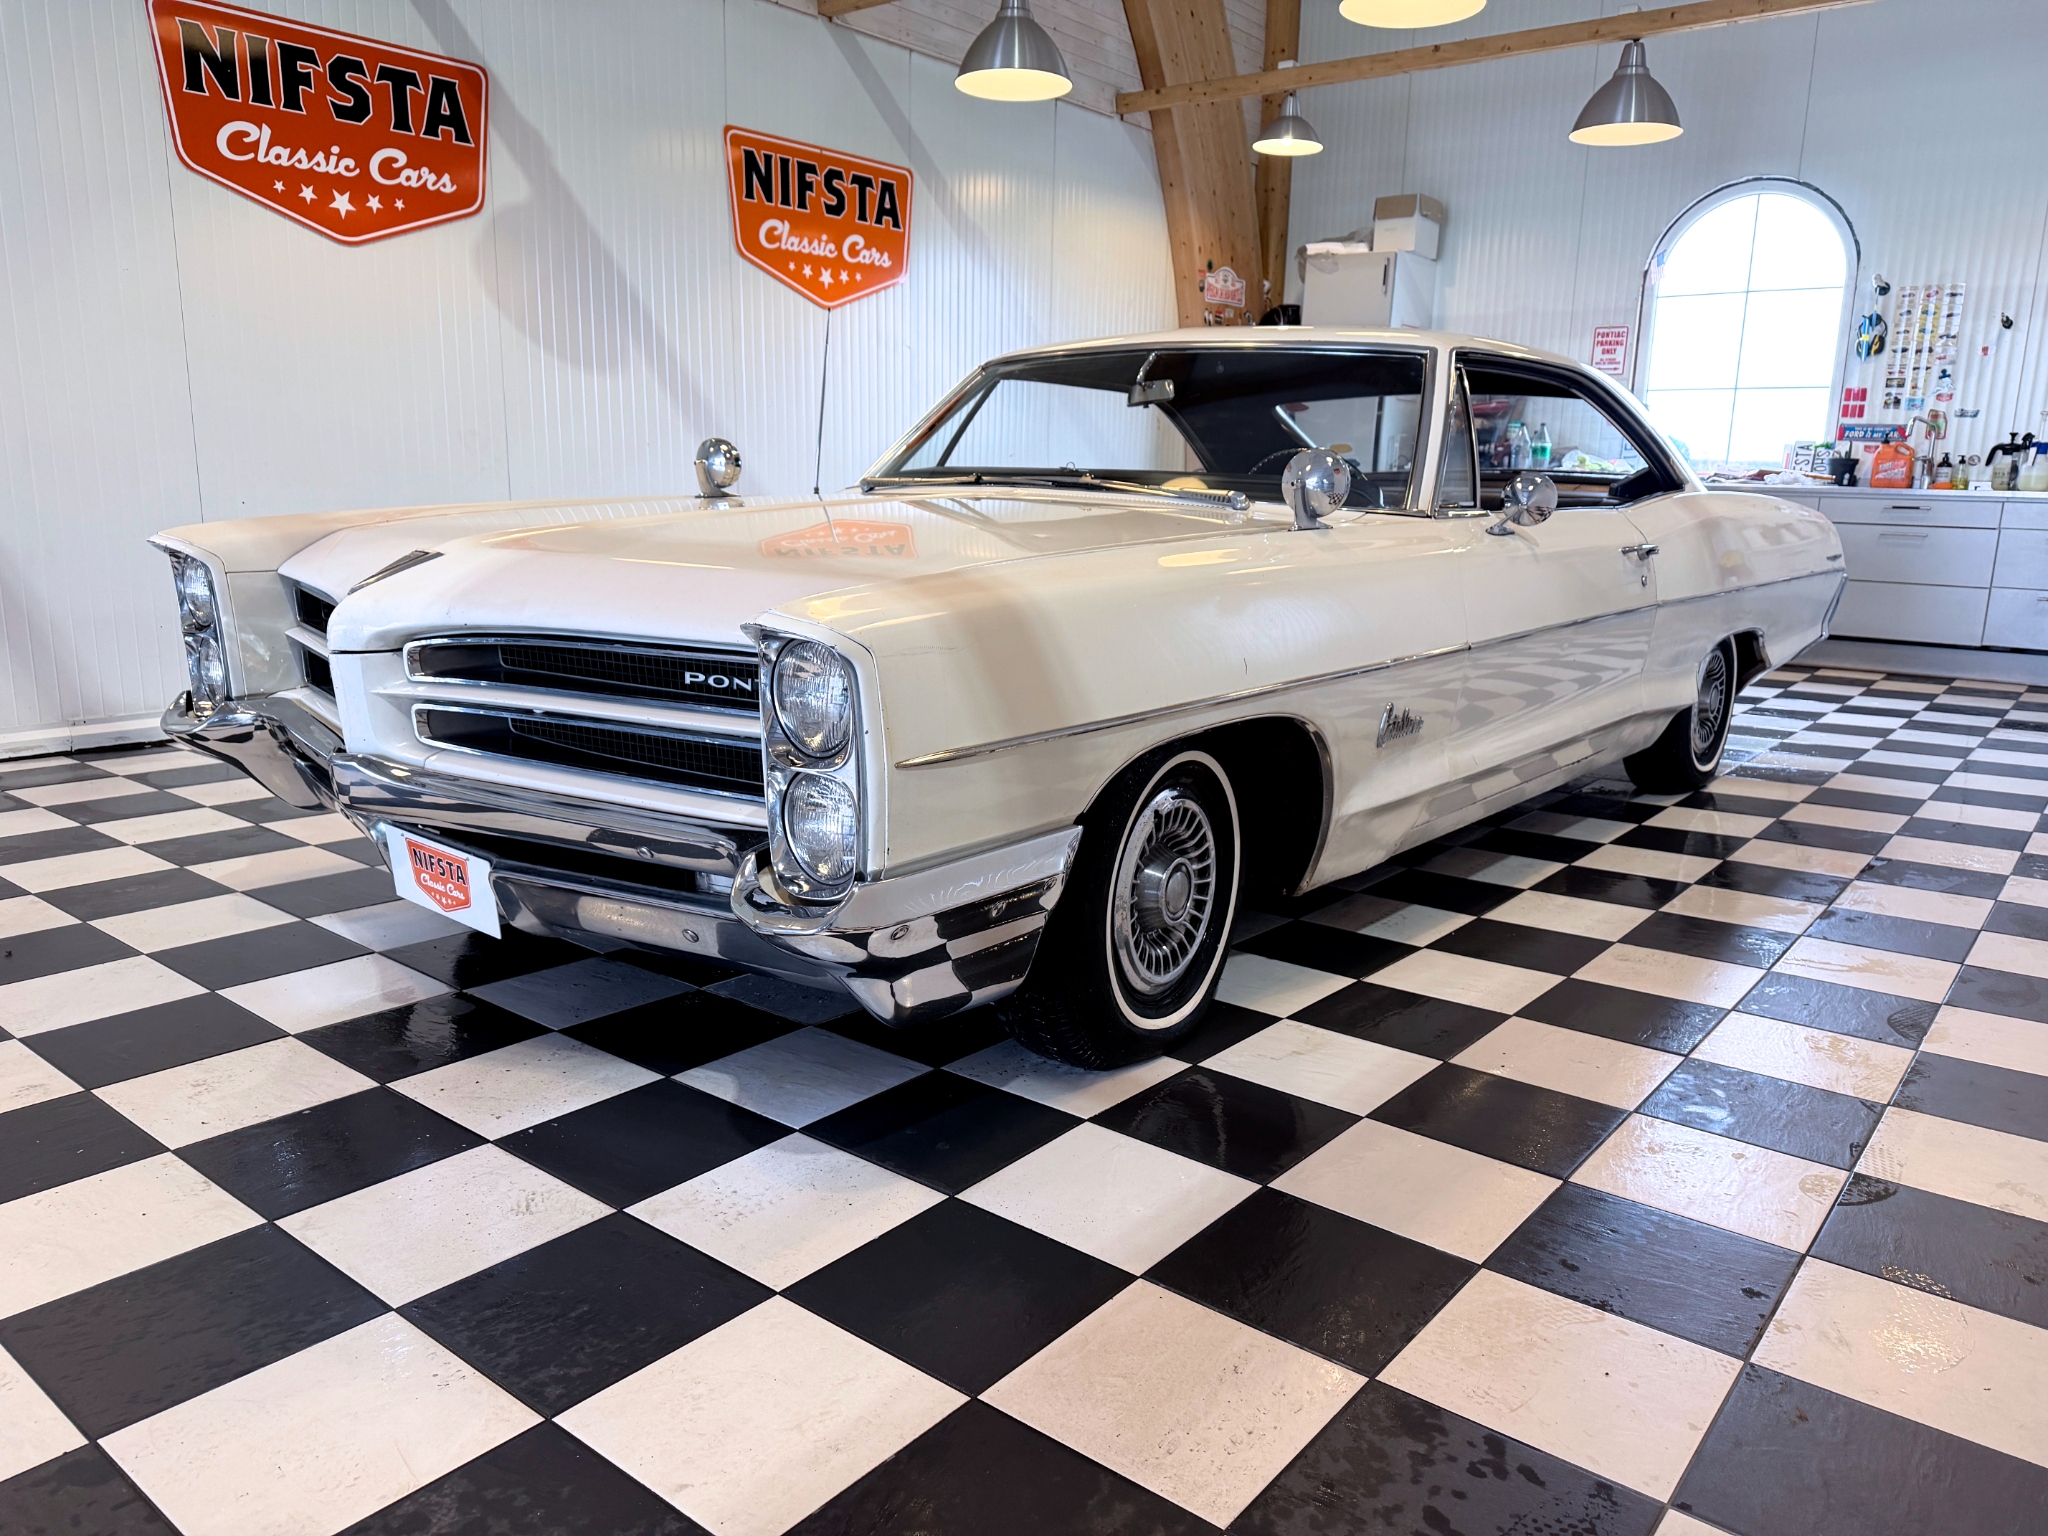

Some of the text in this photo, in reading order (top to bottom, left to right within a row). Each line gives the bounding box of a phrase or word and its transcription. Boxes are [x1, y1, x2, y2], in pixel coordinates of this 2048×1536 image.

[175, 17, 475, 147] NIFSTA
[216, 120, 457, 194] Classic Cars
[741, 146, 903, 231] NIFSTA
[759, 218, 892, 267] Classic Cars
[684, 671, 760, 692] PON
[411, 847, 468, 886] NIFSTA
[420, 873, 465, 900] Classic Cars
